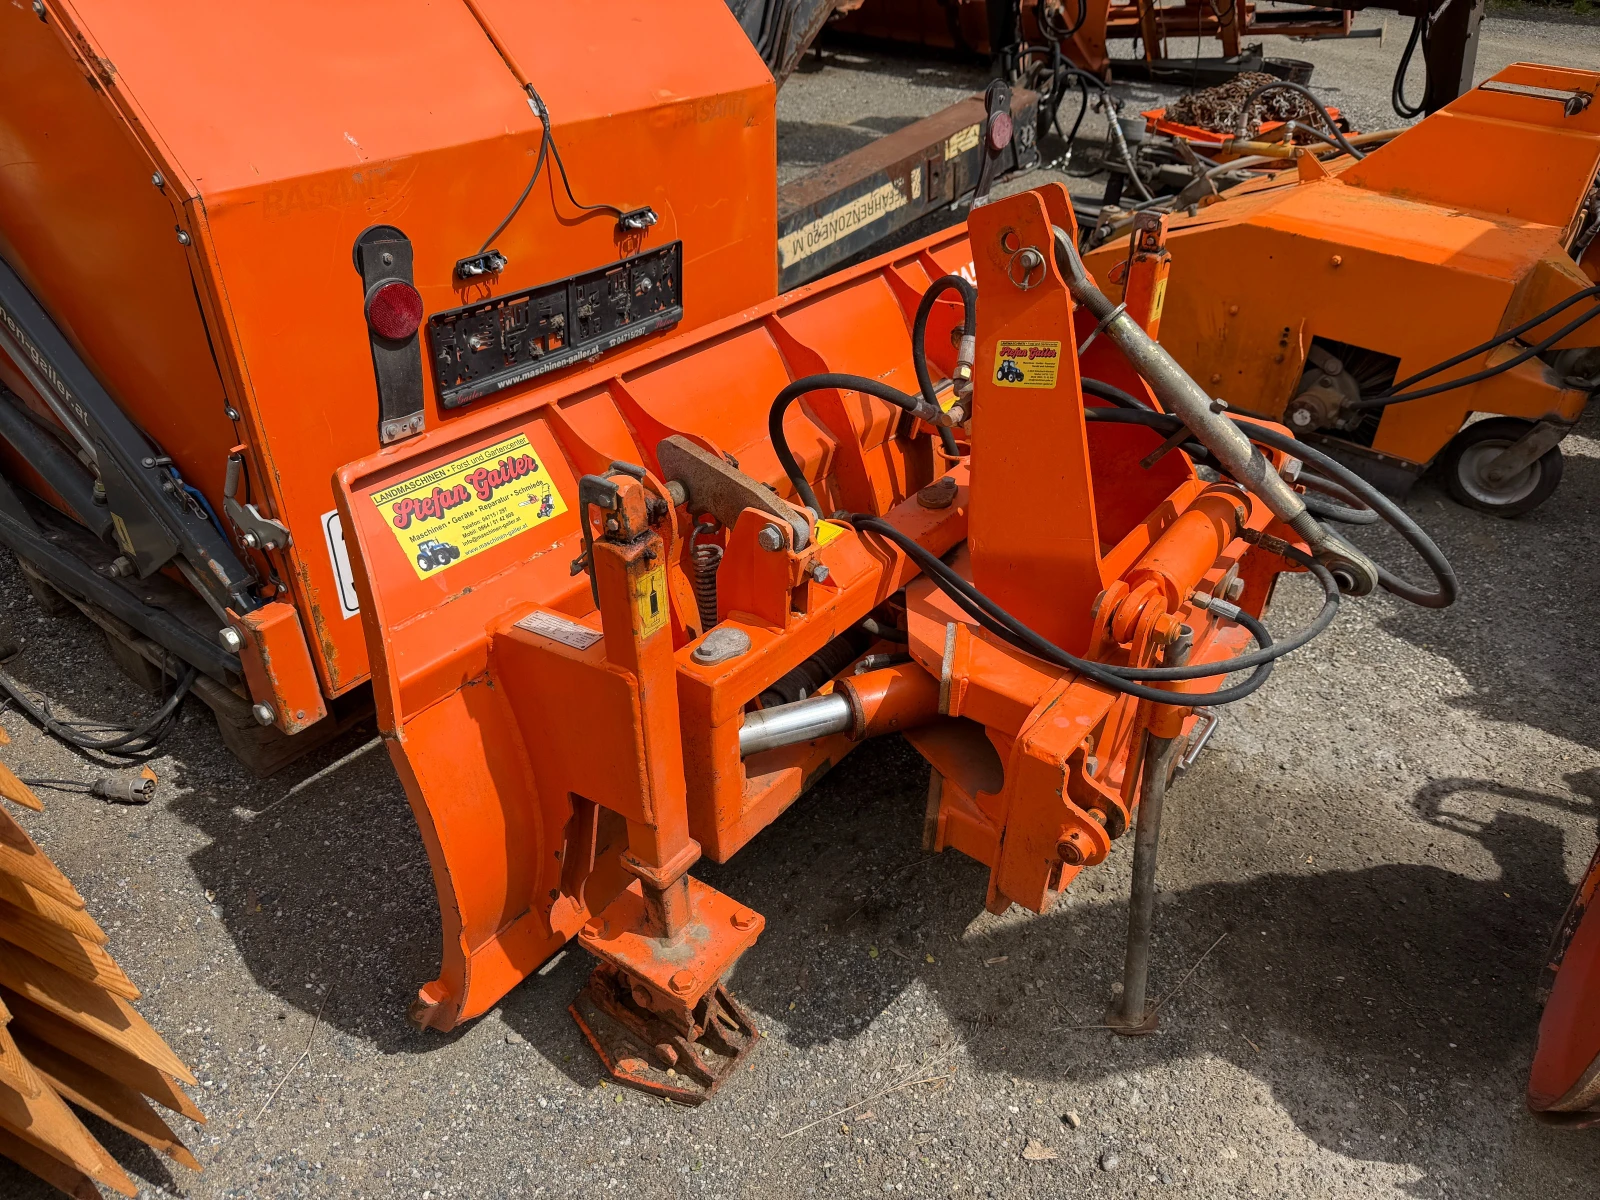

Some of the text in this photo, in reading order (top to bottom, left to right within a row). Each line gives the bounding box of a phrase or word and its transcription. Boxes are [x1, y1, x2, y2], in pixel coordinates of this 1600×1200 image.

[497, 344, 600, 389] www.maschinen-gailer.at
[616, 327, 646, 345] 04715/297
[1028, 347, 1057, 360] Gailer
[373, 436, 527, 504] LANDMASCHINEN Forst und Gartencenter
[392, 453, 540, 530] Stefan Gailer
[409, 480, 545, 544] Maschinen Geräte Reparatur Schmiede
[465, 522, 528, 556] www.maschinen-gailer.at
